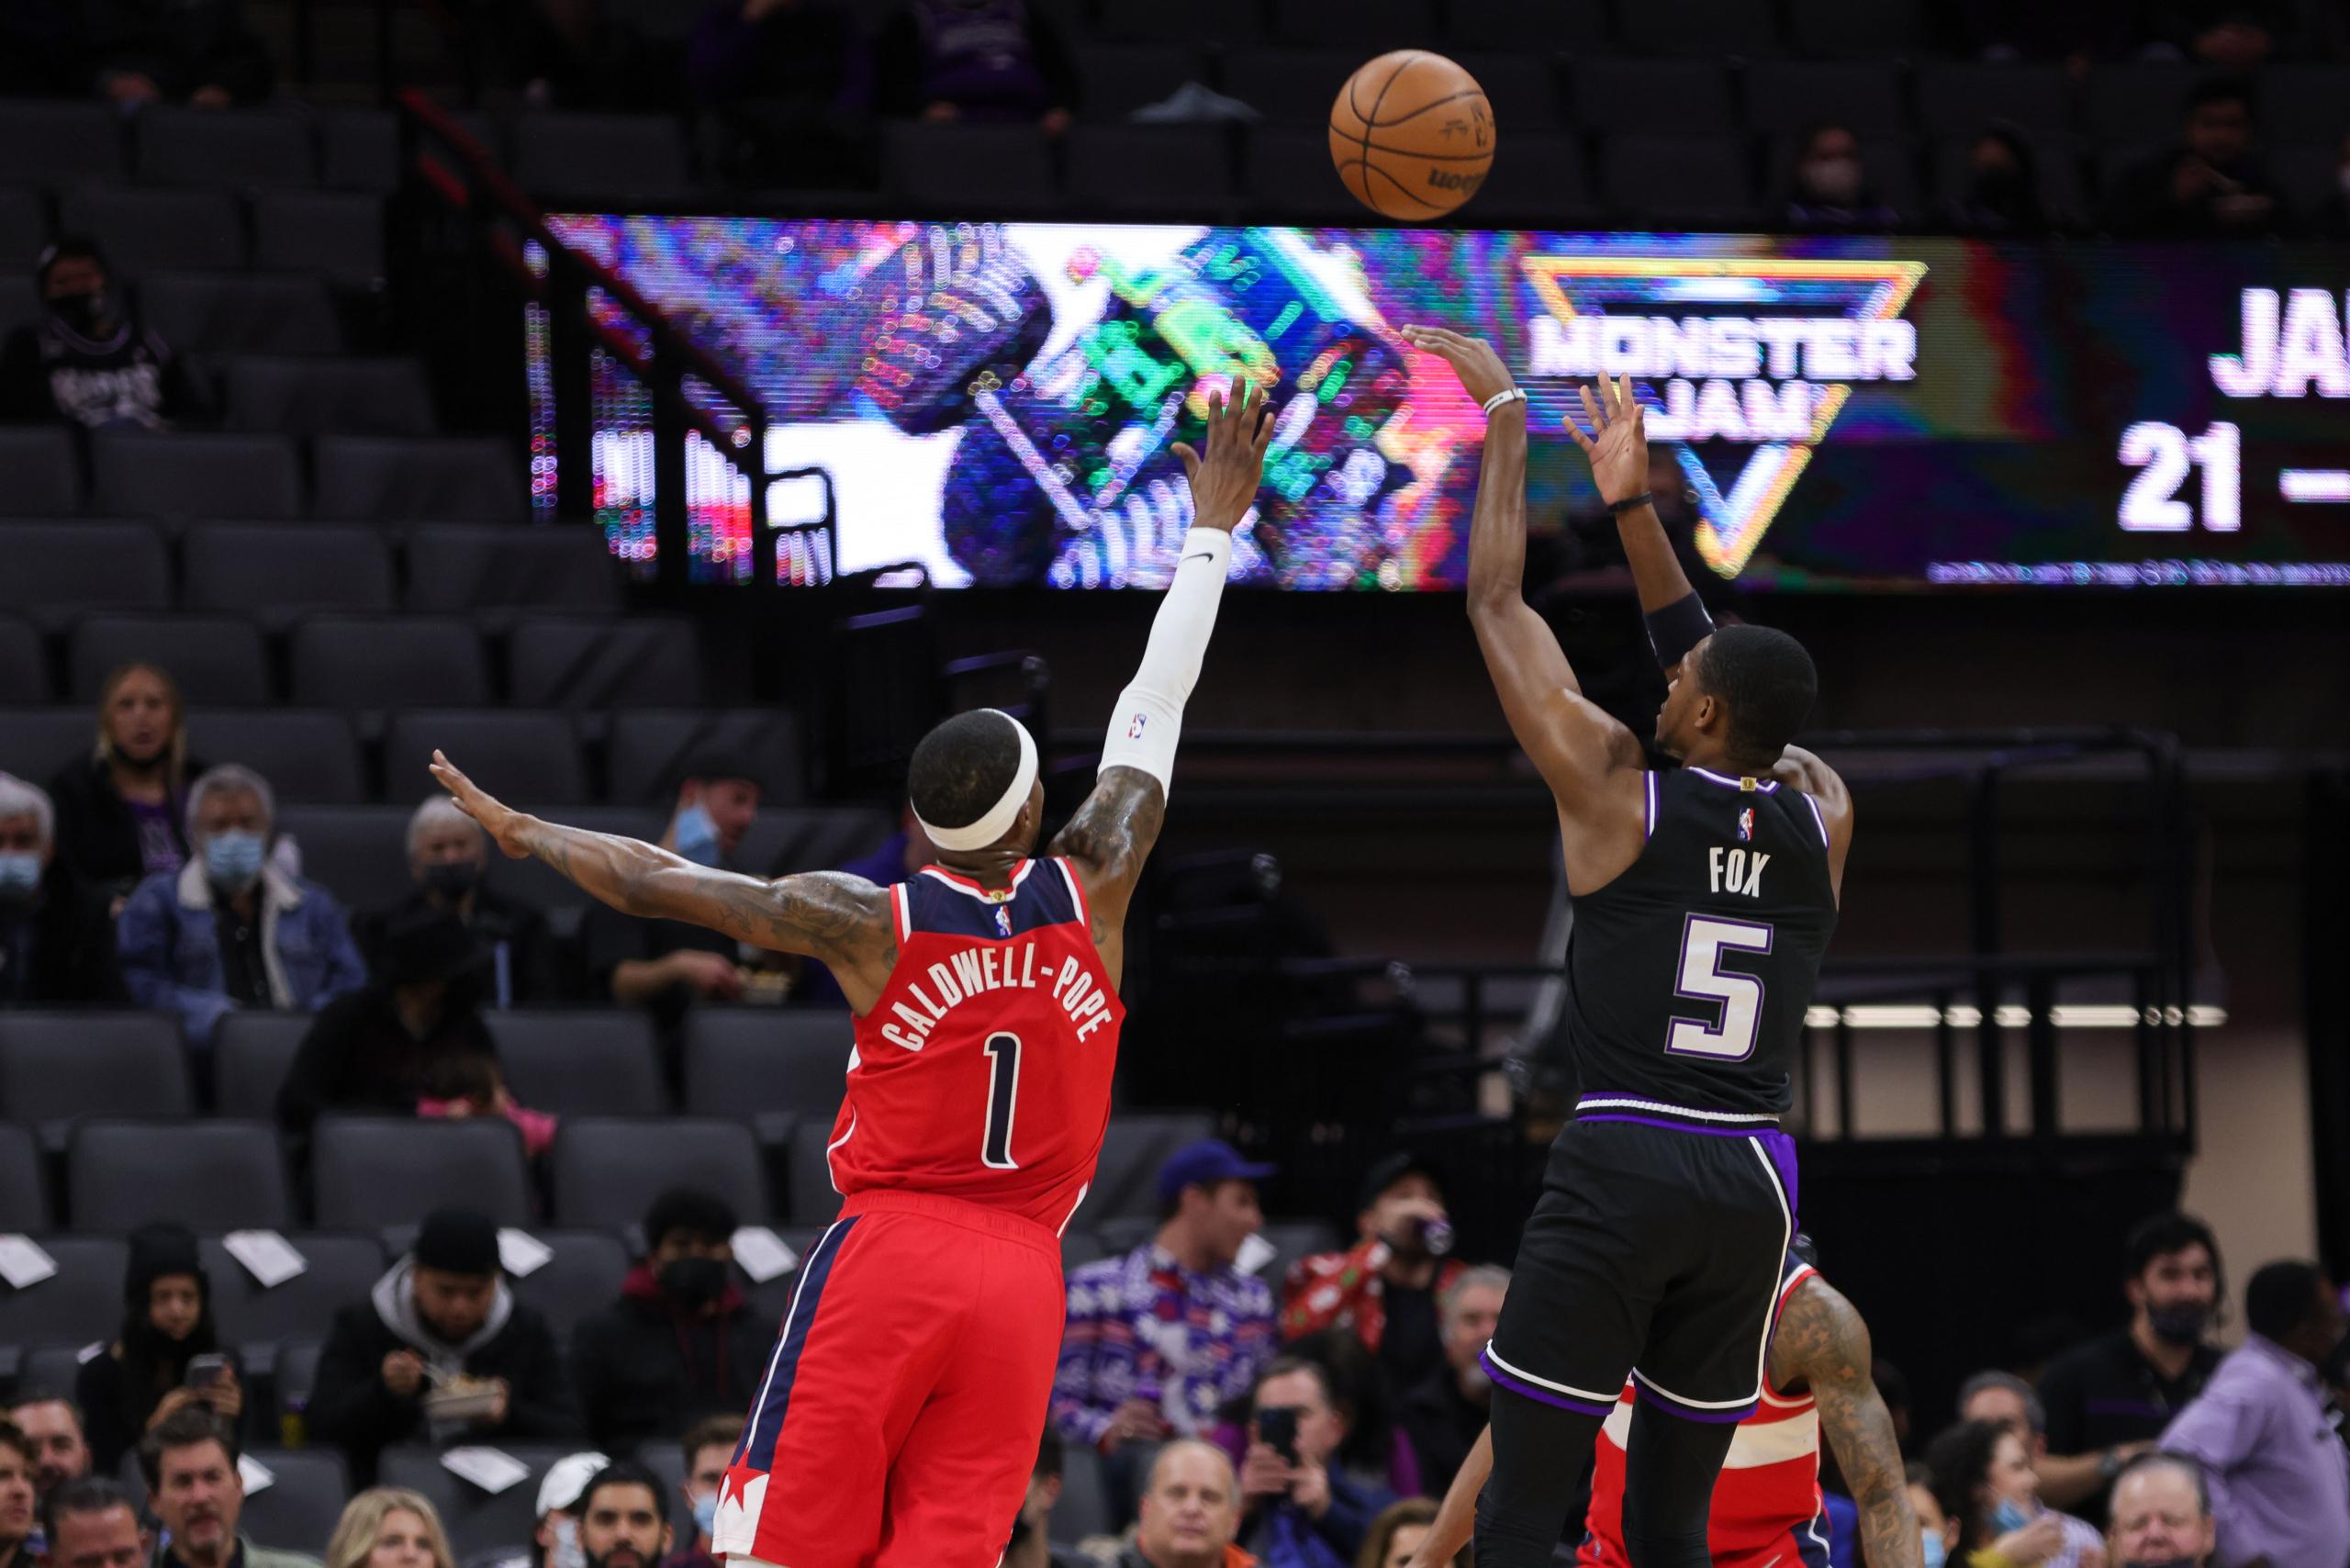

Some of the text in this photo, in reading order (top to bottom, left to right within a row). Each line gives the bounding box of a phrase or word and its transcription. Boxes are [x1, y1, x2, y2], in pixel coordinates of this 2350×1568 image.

[1528, 315, 1917, 380] MONSTER
[2208, 287, 2350, 398] JA
[1645, 379, 1813, 442] JAM
[2117, 420, 2241, 532] 21
[1709, 846, 1771, 898] FOX
[881, 943, 1112, 1051] CALDWELL-POPE
[1663, 912, 1774, 1062] 5
[981, 1031, 1022, 1169] 1
